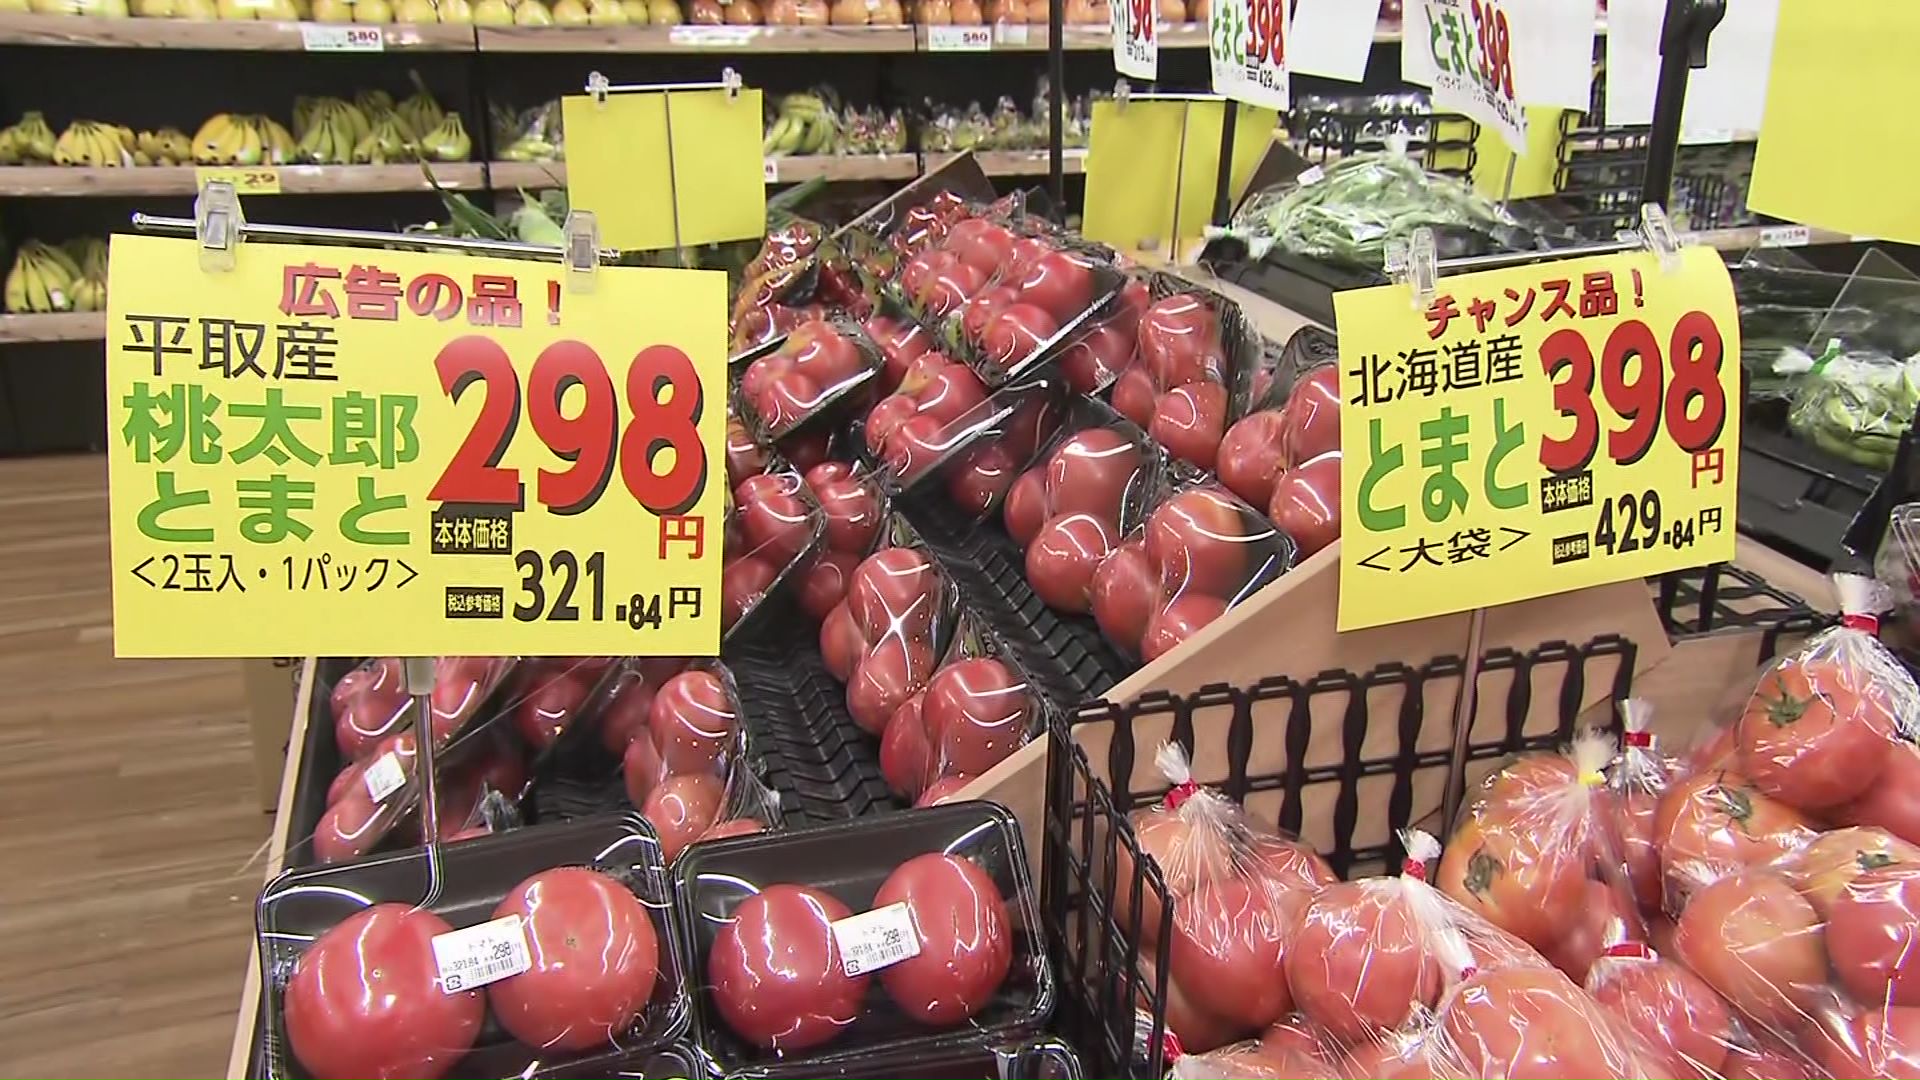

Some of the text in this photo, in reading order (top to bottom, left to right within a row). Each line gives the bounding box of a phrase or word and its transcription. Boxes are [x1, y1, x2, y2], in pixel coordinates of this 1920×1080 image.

[1246, 0, 1284, 67] 398
[1424, 4, 1481, 86] とまと
[1471, 0, 1514, 101] 398
[278, 263, 561, 327] 広告の品！
[1424, 269, 1645, 340] チャンス品！
[122, 313, 339, 381] 平取産
[1349, 334, 1524, 407] 北海道産
[121, 381, 420, 469] 桃太郎
[427, 334, 709, 515] 298
[1538, 310, 1726, 475] 398
[1357, 397, 1529, 532] とまと
[1542, 477, 1592, 507] 本体価格
[137, 470, 412, 545] とまと
[434, 518, 511, 548] 本体価格
